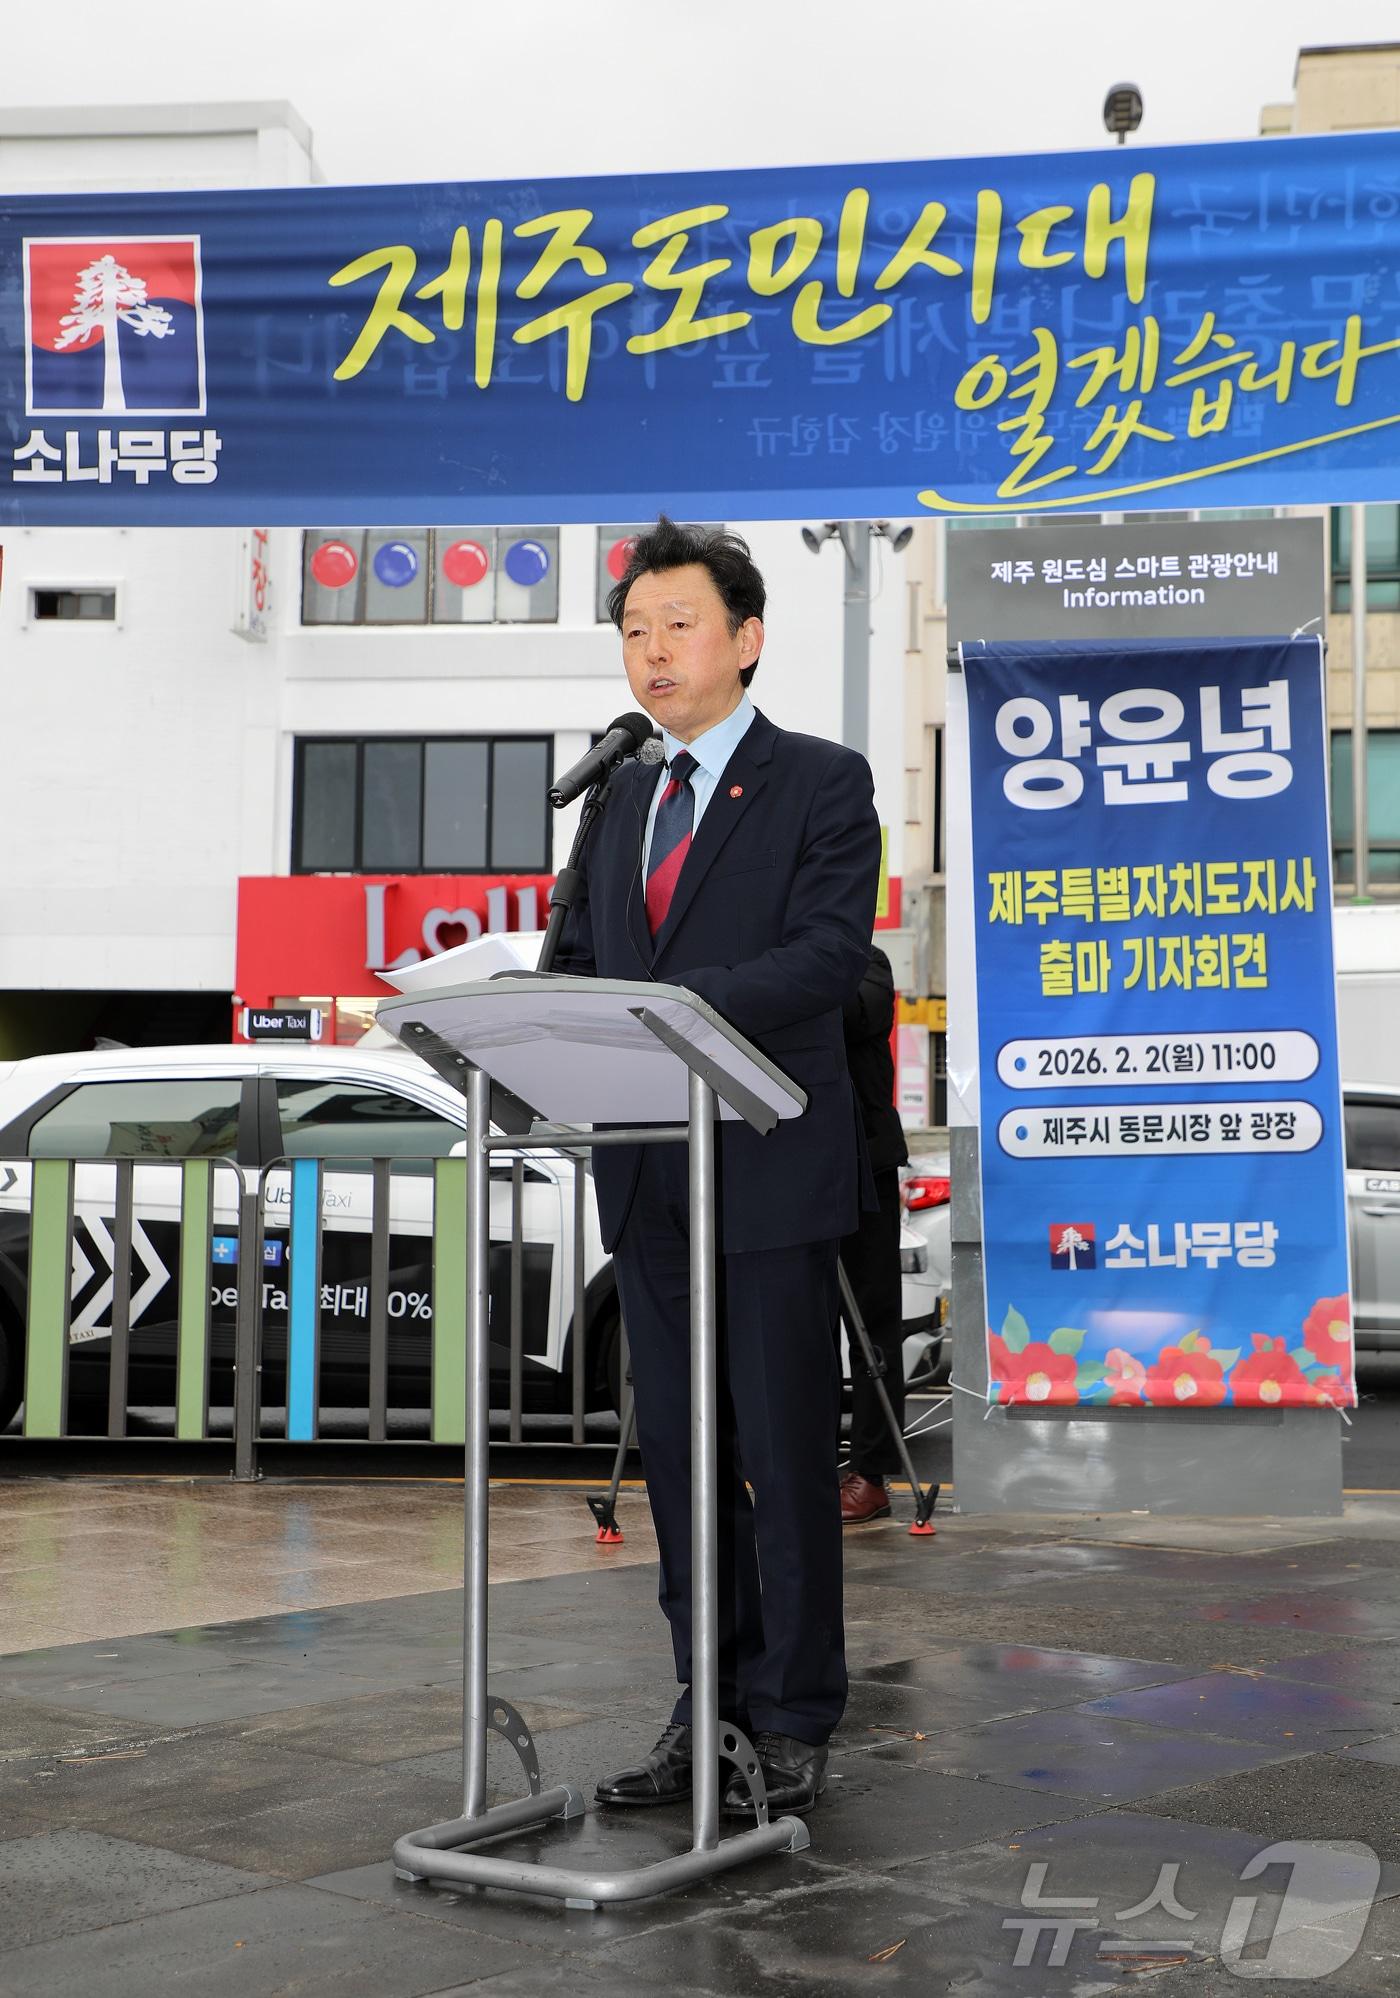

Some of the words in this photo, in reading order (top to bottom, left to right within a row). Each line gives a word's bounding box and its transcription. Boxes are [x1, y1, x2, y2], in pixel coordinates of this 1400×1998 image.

[12, 429, 222, 484] 소나무당
[990, 560, 1035, 585] 제주
[1041, 557, 1107, 583] 원도심
[1114, 555, 1182, 579] 스마트
[1187, 551, 1279, 578] 관광안내
[1063, 585, 1205, 608] Information
[995, 679, 1293, 810] 양윤녕
[988, 857, 1317, 925] 제주특별자치도지사
[1040, 940, 1111, 996] 출마
[1122, 932, 1268, 991] 기자회견
[253, 1015, 283, 1028] Uber
[285, 1015, 306, 1028] Taxi
[1038, 1047, 1108, 1076] 2026.
[1211, 1042, 1276, 1070] 11:00
[1042, 1116, 1110, 1145] 제주시
[1119, 1114, 1211, 1144] 동문시장
[1219, 1113, 1242, 1141] 앞
[1250, 1111, 1296, 1140] 광장
[1104, 1221, 1279, 1270] 소나무당
